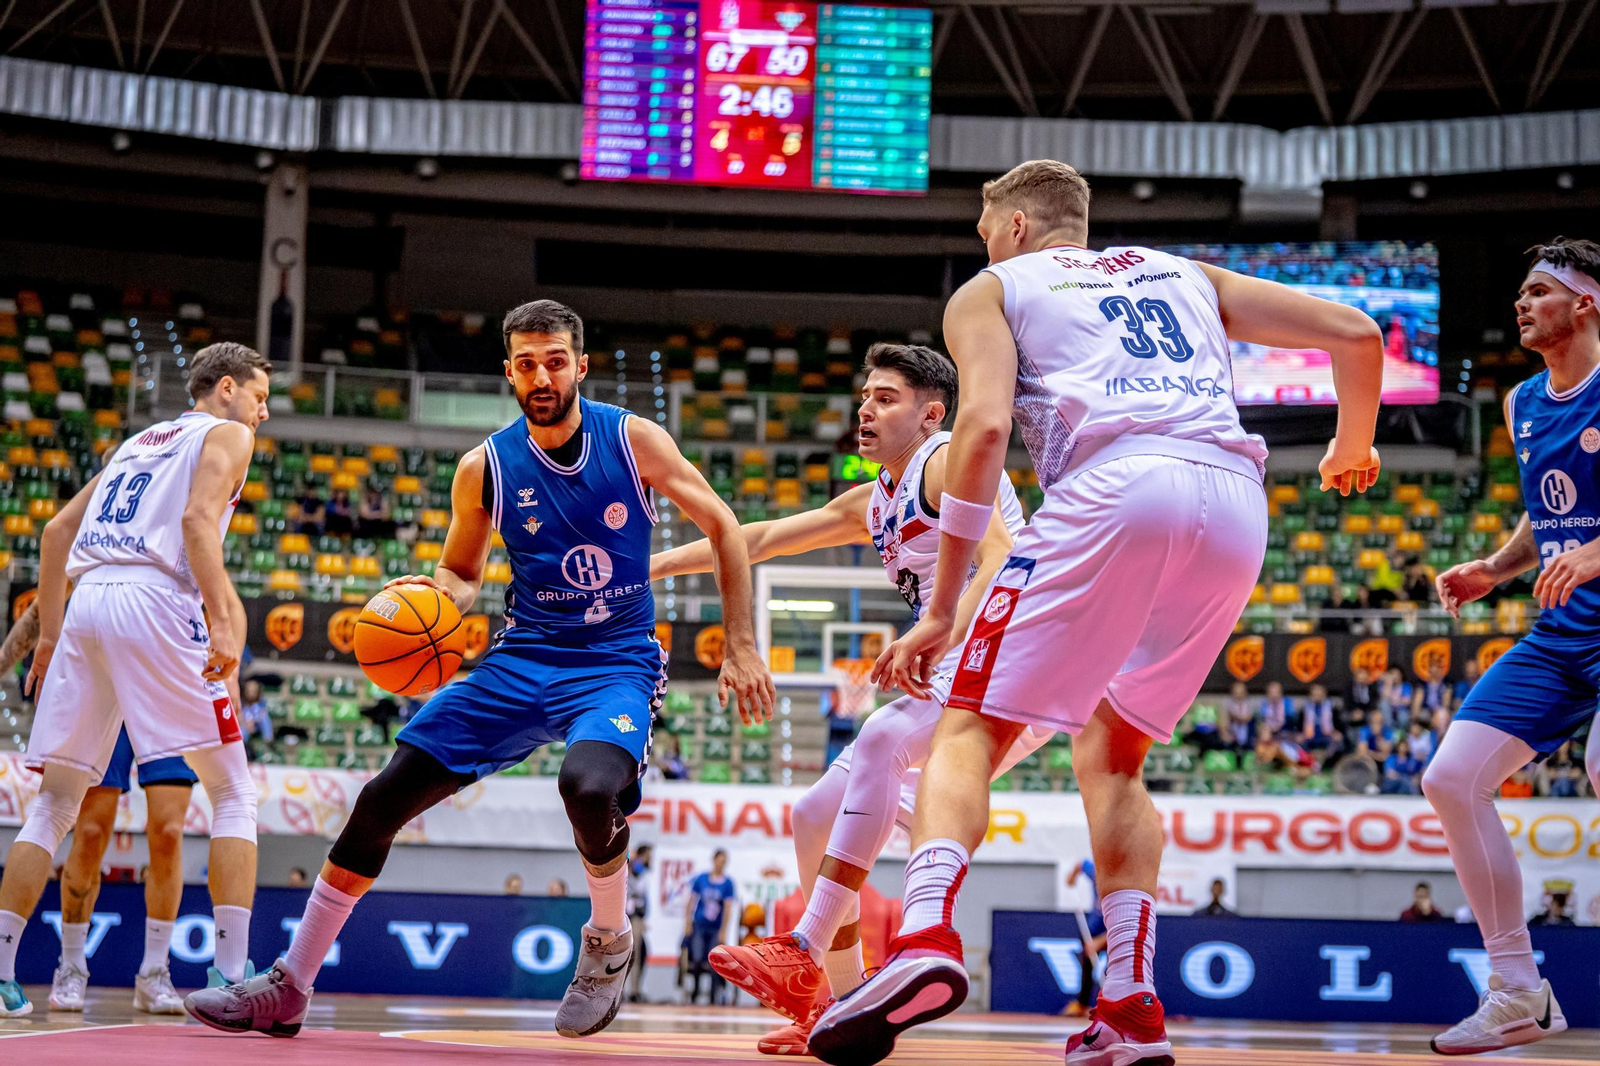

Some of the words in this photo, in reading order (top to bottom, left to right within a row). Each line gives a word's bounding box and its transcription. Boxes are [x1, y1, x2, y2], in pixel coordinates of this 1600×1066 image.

[706, 42, 750, 72] 67
[718, 83, 794, 118] 2:46
[1048, 281, 1114, 292] indupanel
[1098, 295, 1195, 363] 33
[96, 472, 153, 524] 13
[1531, 518, 1558, 530] RUPO
[536, 590, 588, 602] GRUPO
[1160, 808, 1449, 855] URGOS
[1027, 936, 1600, 1002] VOLV
